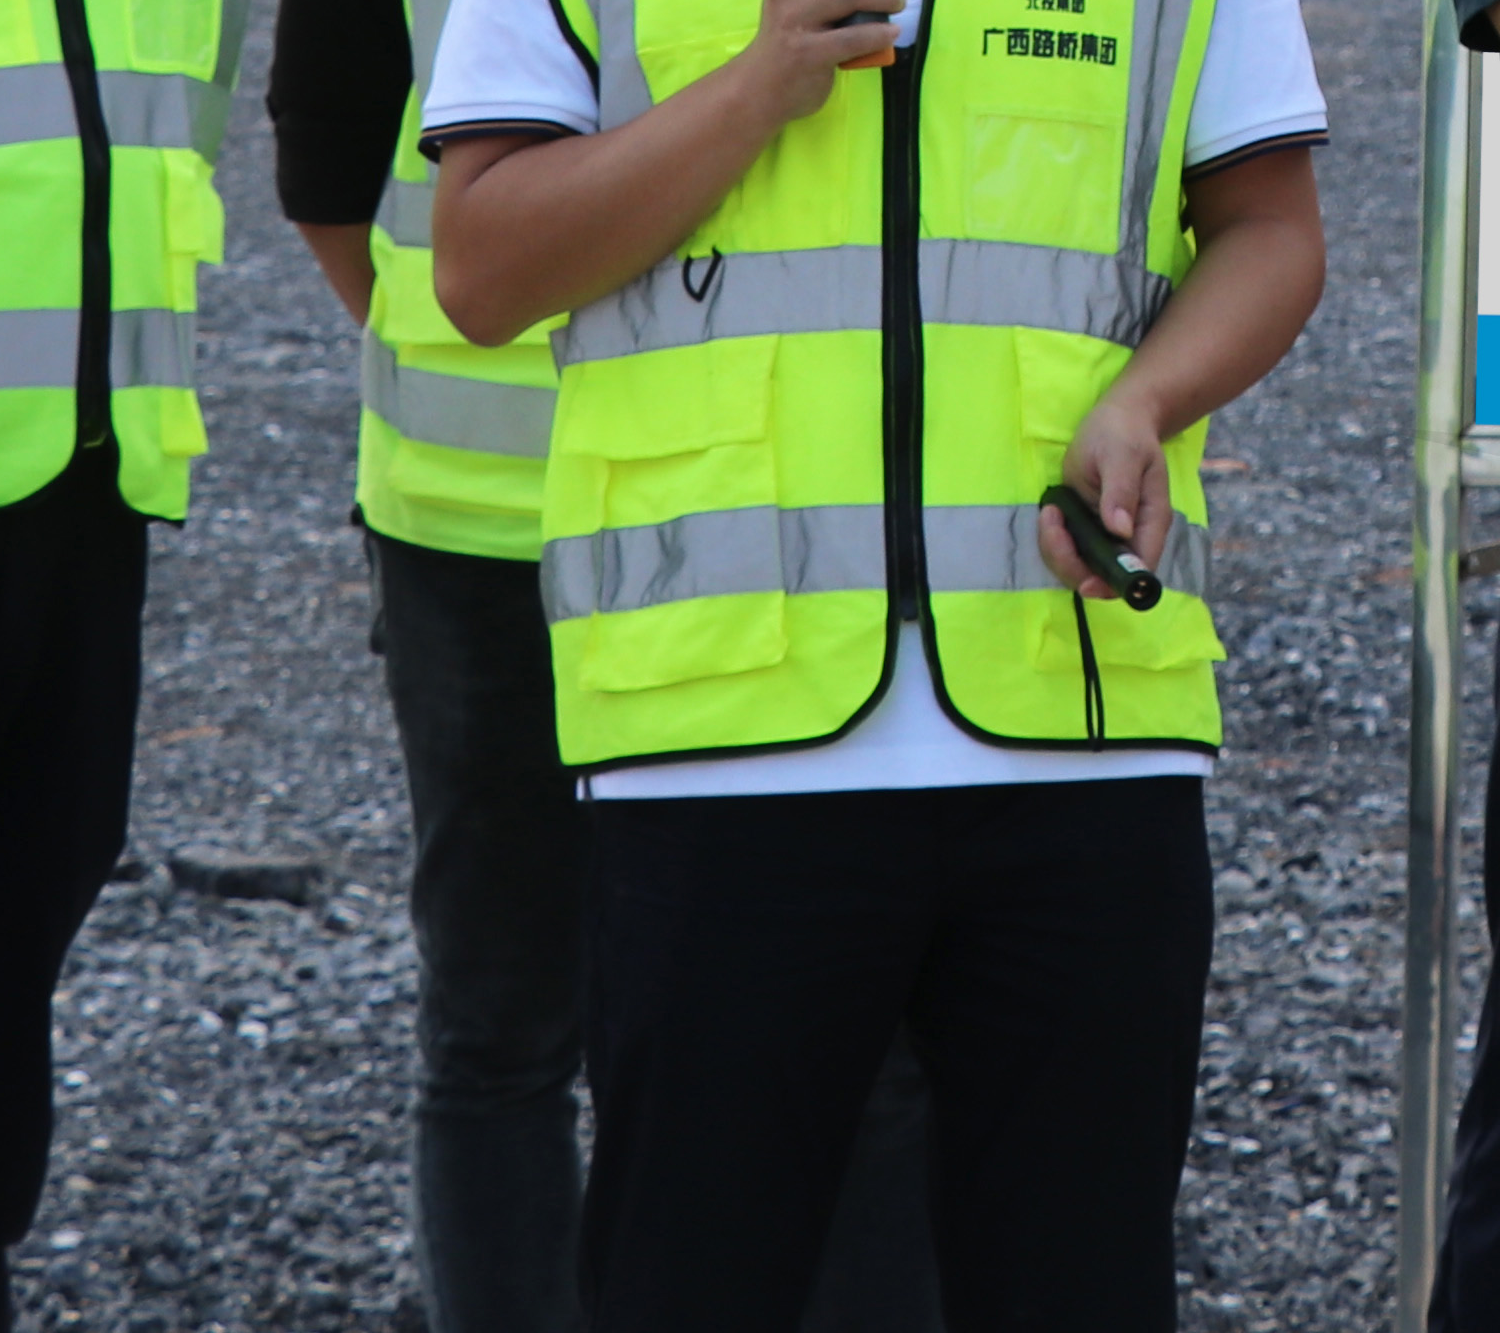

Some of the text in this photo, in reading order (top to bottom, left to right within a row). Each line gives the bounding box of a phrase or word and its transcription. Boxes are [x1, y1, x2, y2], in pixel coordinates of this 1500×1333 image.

[982, 27, 1118, 66] 广西路桥集团
